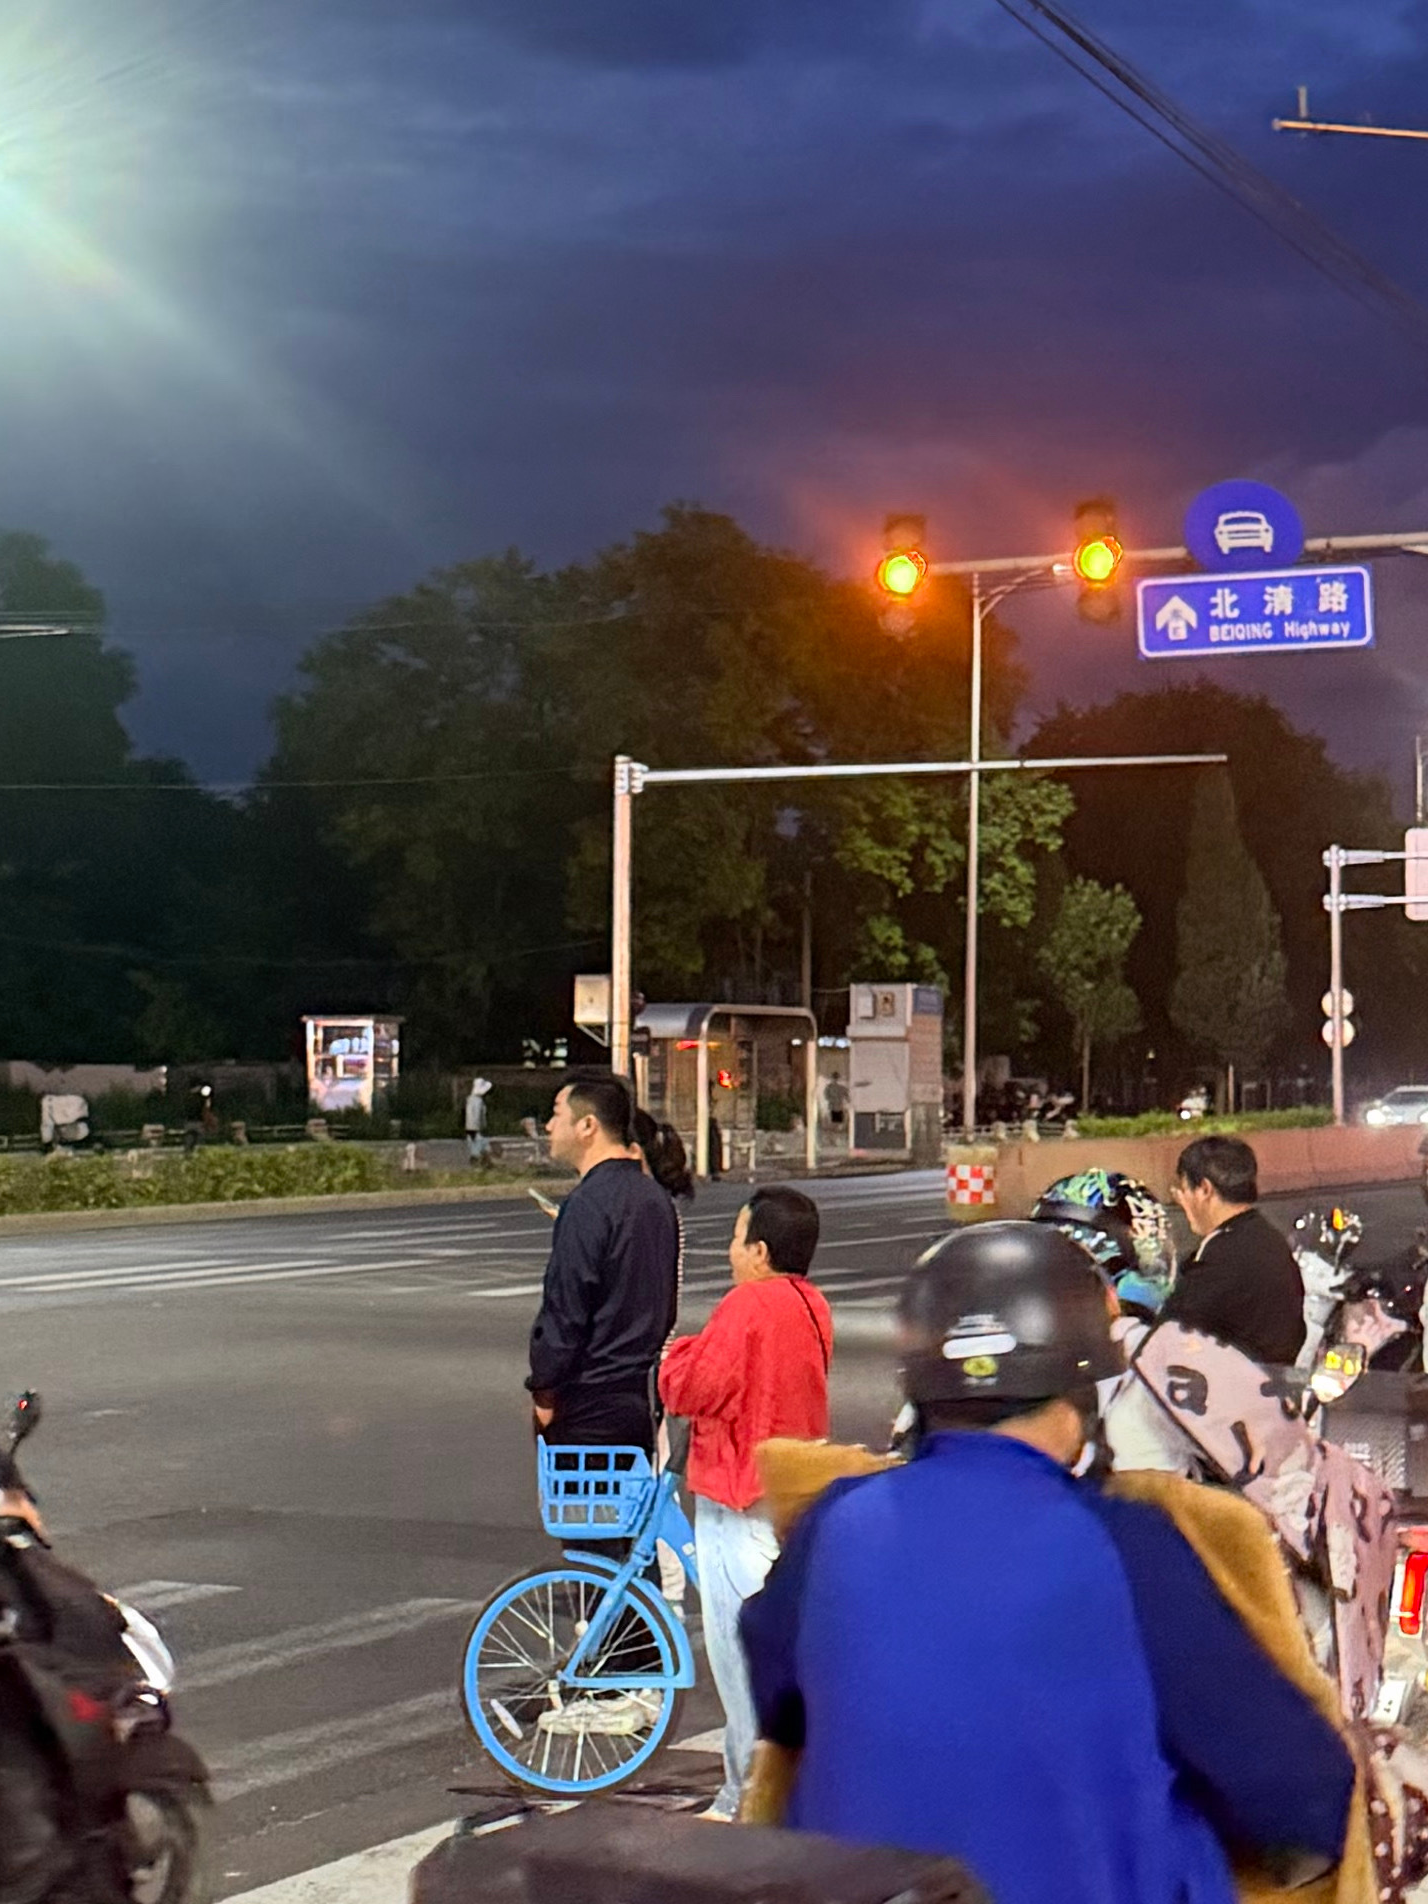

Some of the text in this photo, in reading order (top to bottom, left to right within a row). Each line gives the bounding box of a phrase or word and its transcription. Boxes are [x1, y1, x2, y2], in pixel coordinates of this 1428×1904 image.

[1209, 581, 1349, 619] 北清路
[1209, 621, 1351, 642] BEIQING Highway
